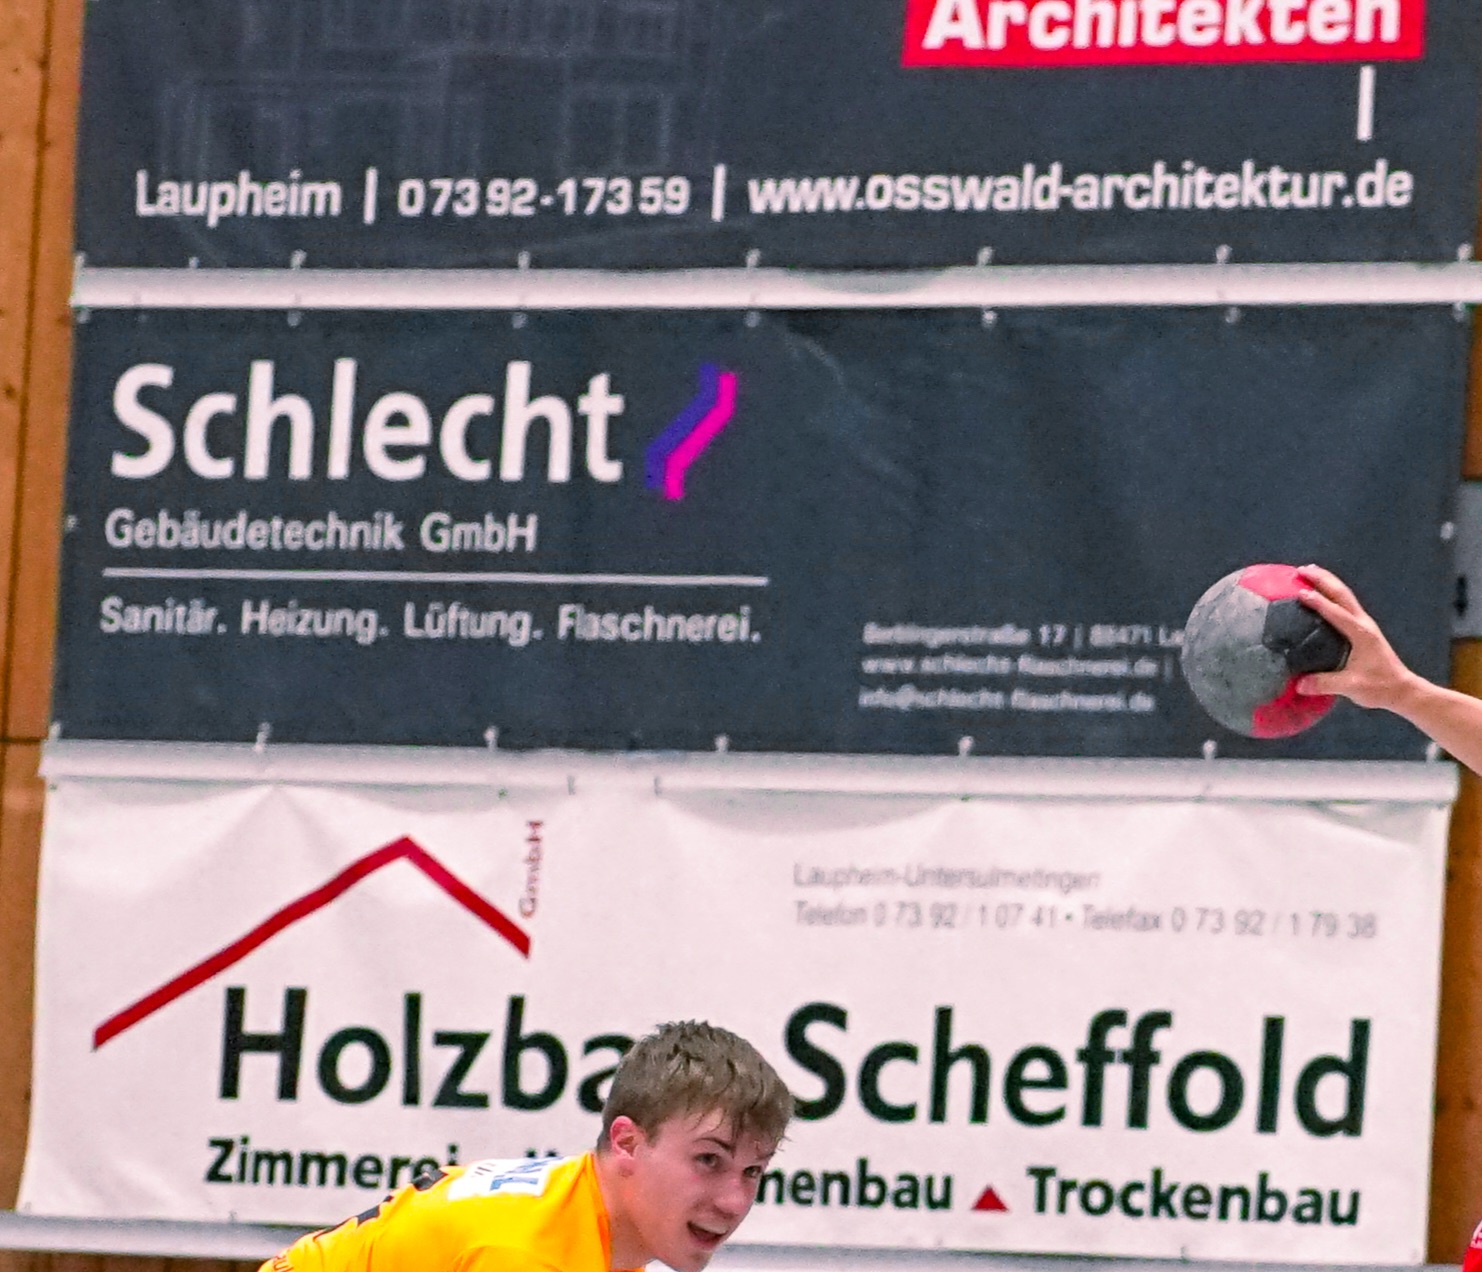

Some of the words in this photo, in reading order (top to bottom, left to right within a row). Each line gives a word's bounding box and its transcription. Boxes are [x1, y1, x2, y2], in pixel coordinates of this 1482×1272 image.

[135, 167, 342, 229] Laupheim
[748, 159, 1414, 214] www.osswald-architektur.de
[110, 357, 624, 482] Schlecht
[104, 508, 404, 552] Gebäudetechnik
[419, 511, 537, 553] GmbH
[99, 595, 228, 635] Sanitär.
[240, 600, 389, 645] Heizung.
[403, 601, 544, 647] Lüftung.
[556, 604, 762, 644] Flaschnerei.
[782, 1000, 1373, 1139] Scheffold
[755, 1156, 954, 1211] nenbau
[1026, 1166, 1362, 1227] Trockenbau
